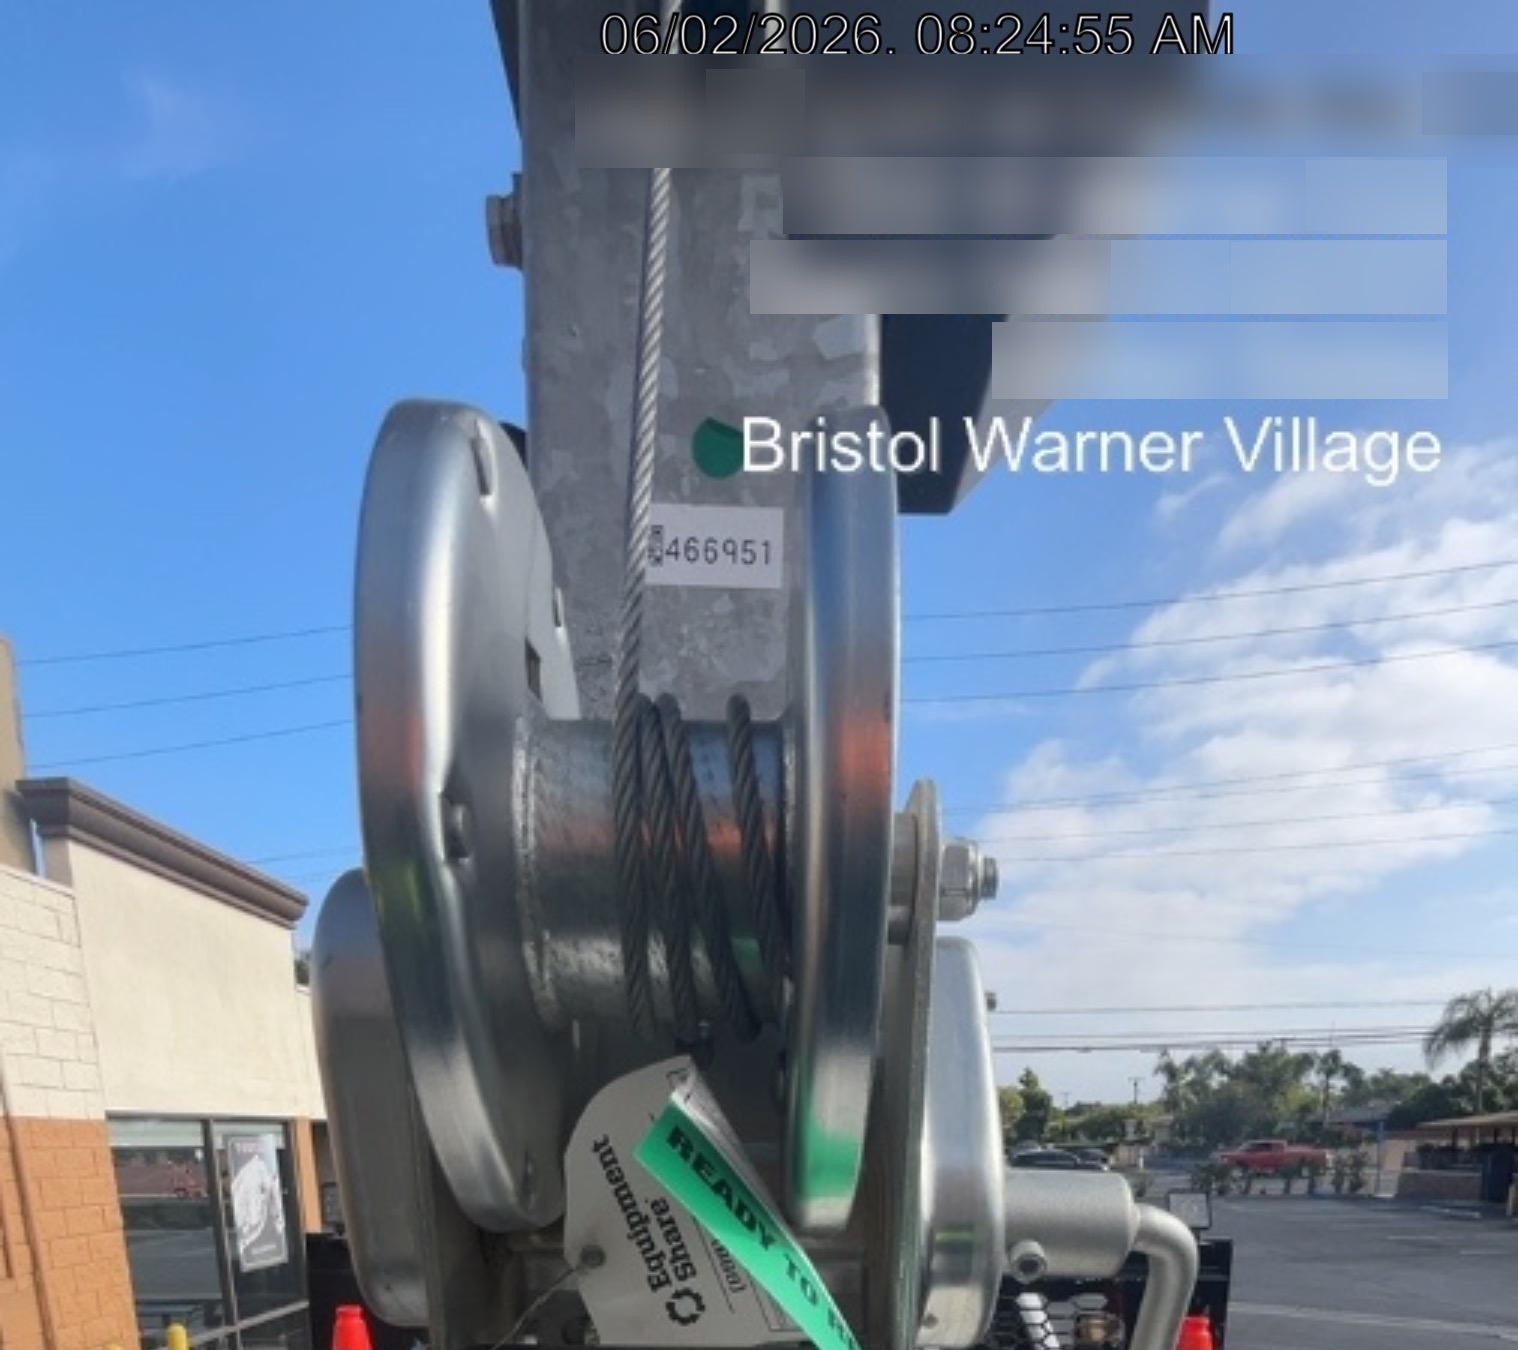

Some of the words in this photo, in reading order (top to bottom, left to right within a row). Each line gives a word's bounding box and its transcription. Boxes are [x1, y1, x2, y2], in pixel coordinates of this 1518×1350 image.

[665, 536, 771, 566] 466951
[592, 1133, 672, 1292] Equipment
[650, 1197, 697, 1282] Share
[667, 1125, 776, 1250] READY
[784, 1253, 817, 1306] TO
